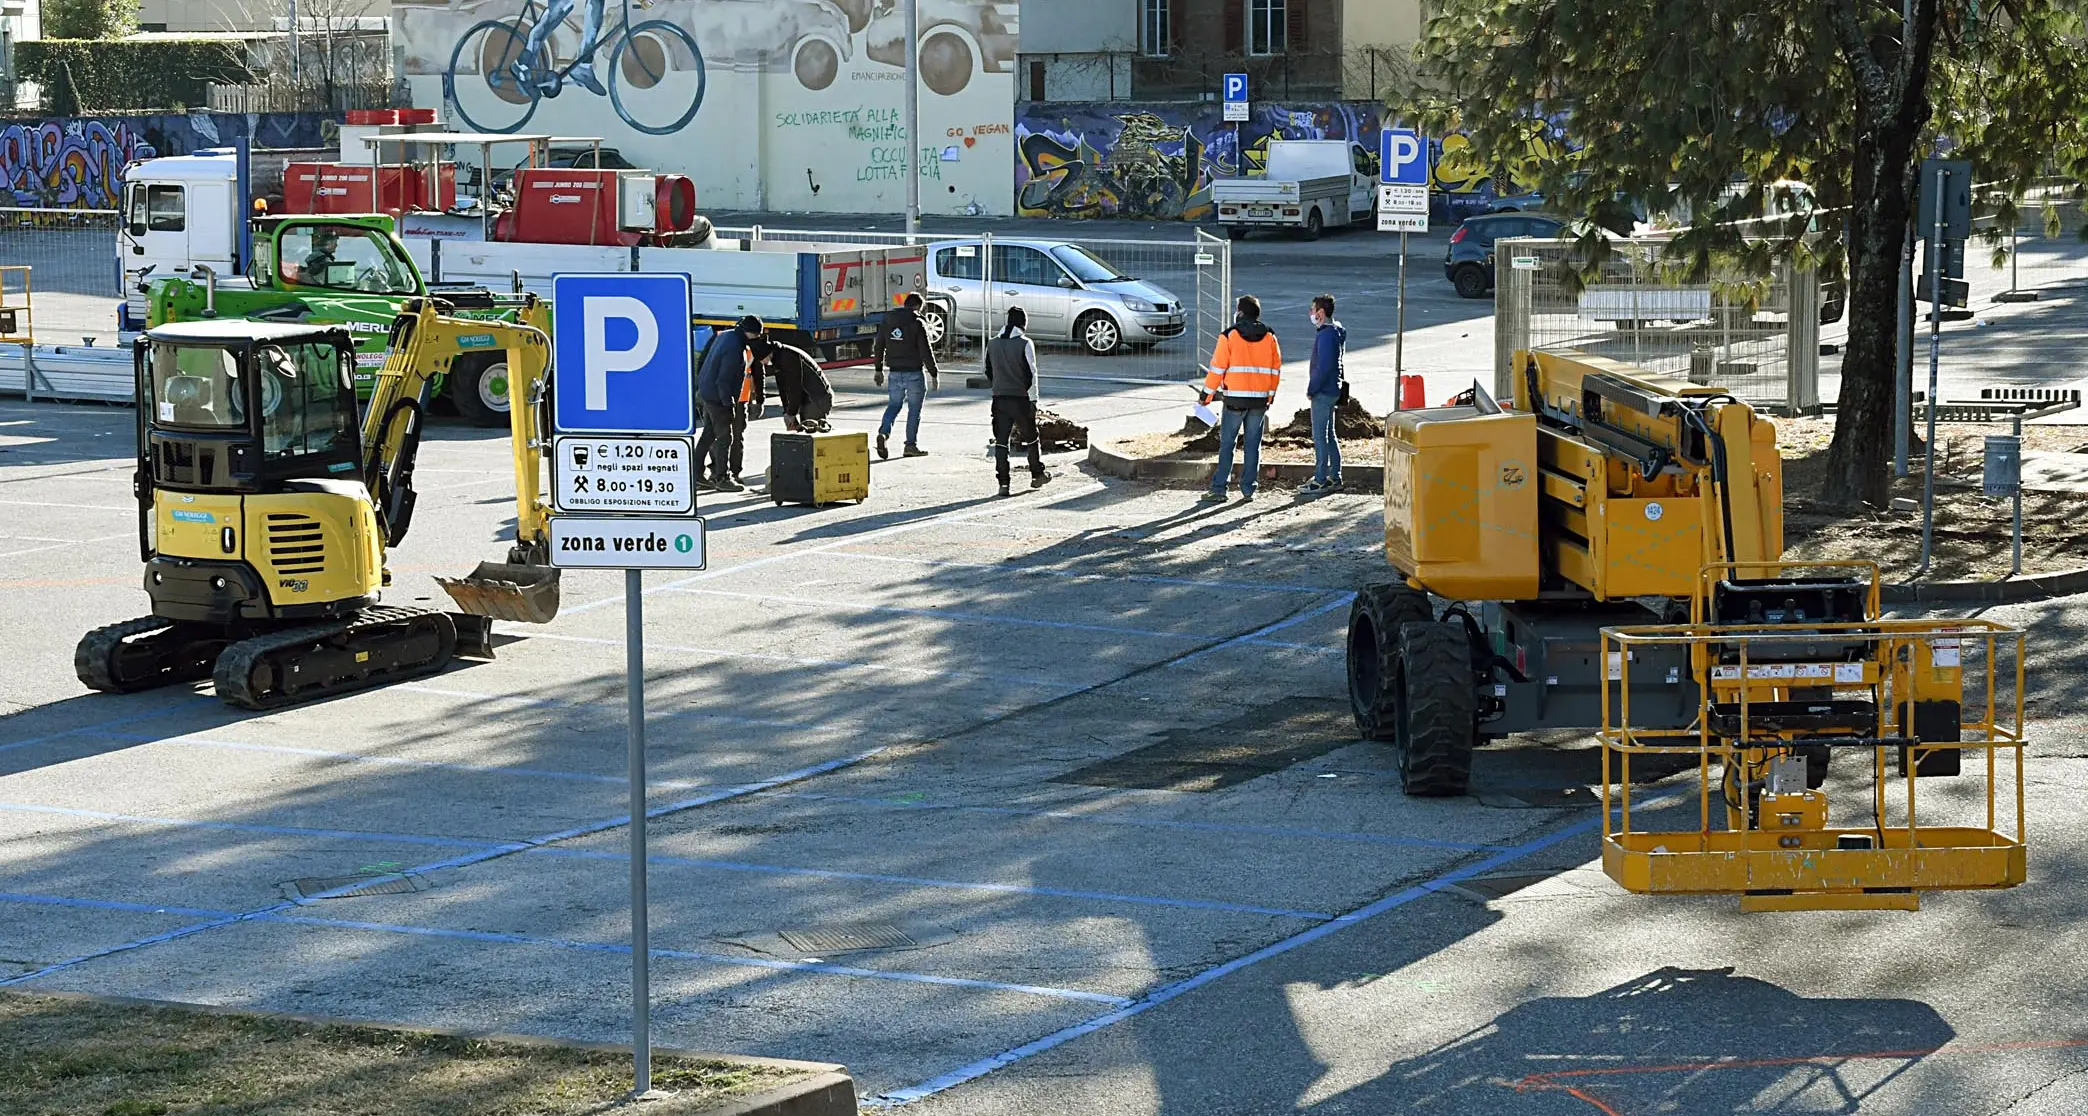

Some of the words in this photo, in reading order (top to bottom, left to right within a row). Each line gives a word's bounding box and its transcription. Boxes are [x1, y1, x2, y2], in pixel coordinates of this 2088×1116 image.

[1228, 77, 1243, 99] P
[866, 107, 899, 124] ALLA
[848, 126, 908, 143] MAGNIFIC
[946, 127, 964, 137] GO
[972, 123, 1009, 136] VEGAN
[871, 147, 939, 166] OCCUTA
[1389, 134, 1419, 179] P
[856, 166, 896, 182] LOTTA
[1398, 218, 1417, 227] verde
[346, 321, 392, 334] MERL
[583, 295, 660, 411] P
[597, 444, 609, 458] €
[597, 463, 618, 472] negli
[621, 463, 643, 472] spazi
[647, 463, 678, 472] segnati
[603, 498, 652, 506] ESPOSIZIONE
[654, 499, 680, 507] TICKET
[561, 536, 606, 551] zona
[612, 532, 667, 552] verde
